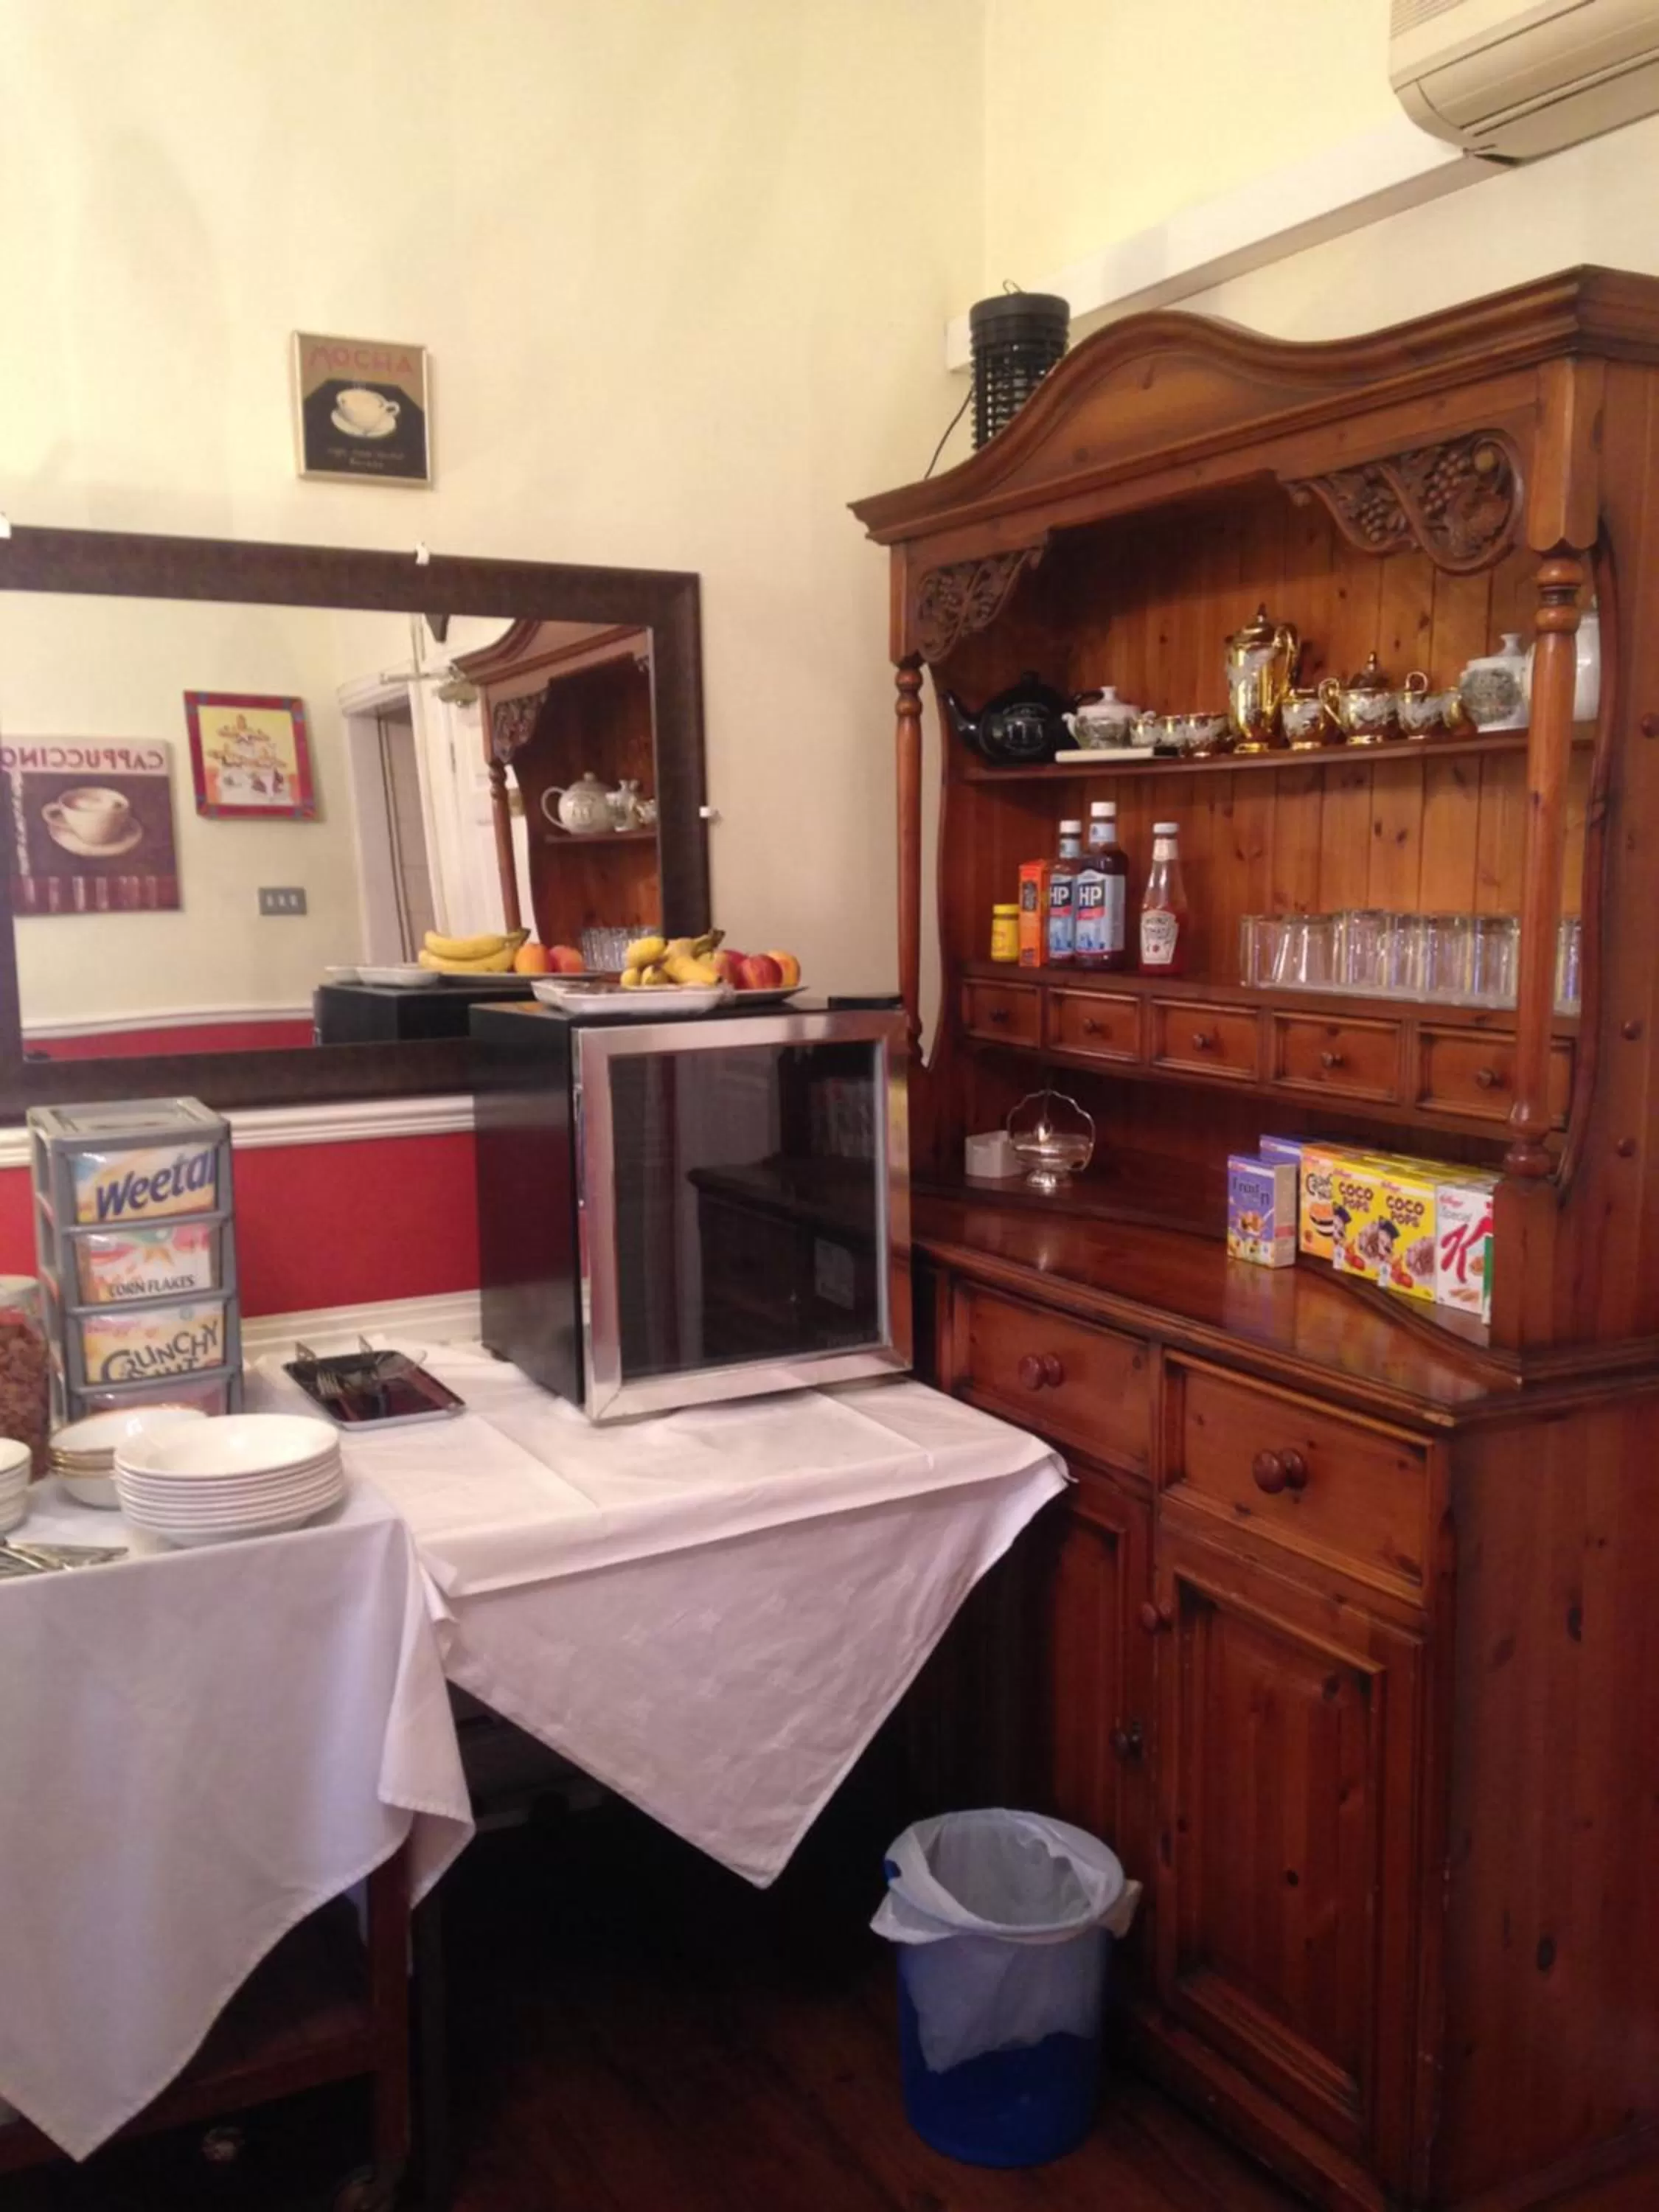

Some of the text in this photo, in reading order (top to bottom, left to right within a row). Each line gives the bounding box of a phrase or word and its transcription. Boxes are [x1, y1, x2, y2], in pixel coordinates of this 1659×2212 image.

[308, 345, 414, 373] MOCHA
[1050, 886, 1069, 905] HP
[1079, 886, 1102, 906] HP
[1338, 1181, 1374, 1201] COCO
[1386, 1195, 1425, 1216] COCO
[1441, 1216, 1493, 1284] K
[108, 1273, 196, 1298] CORN FLAKES
